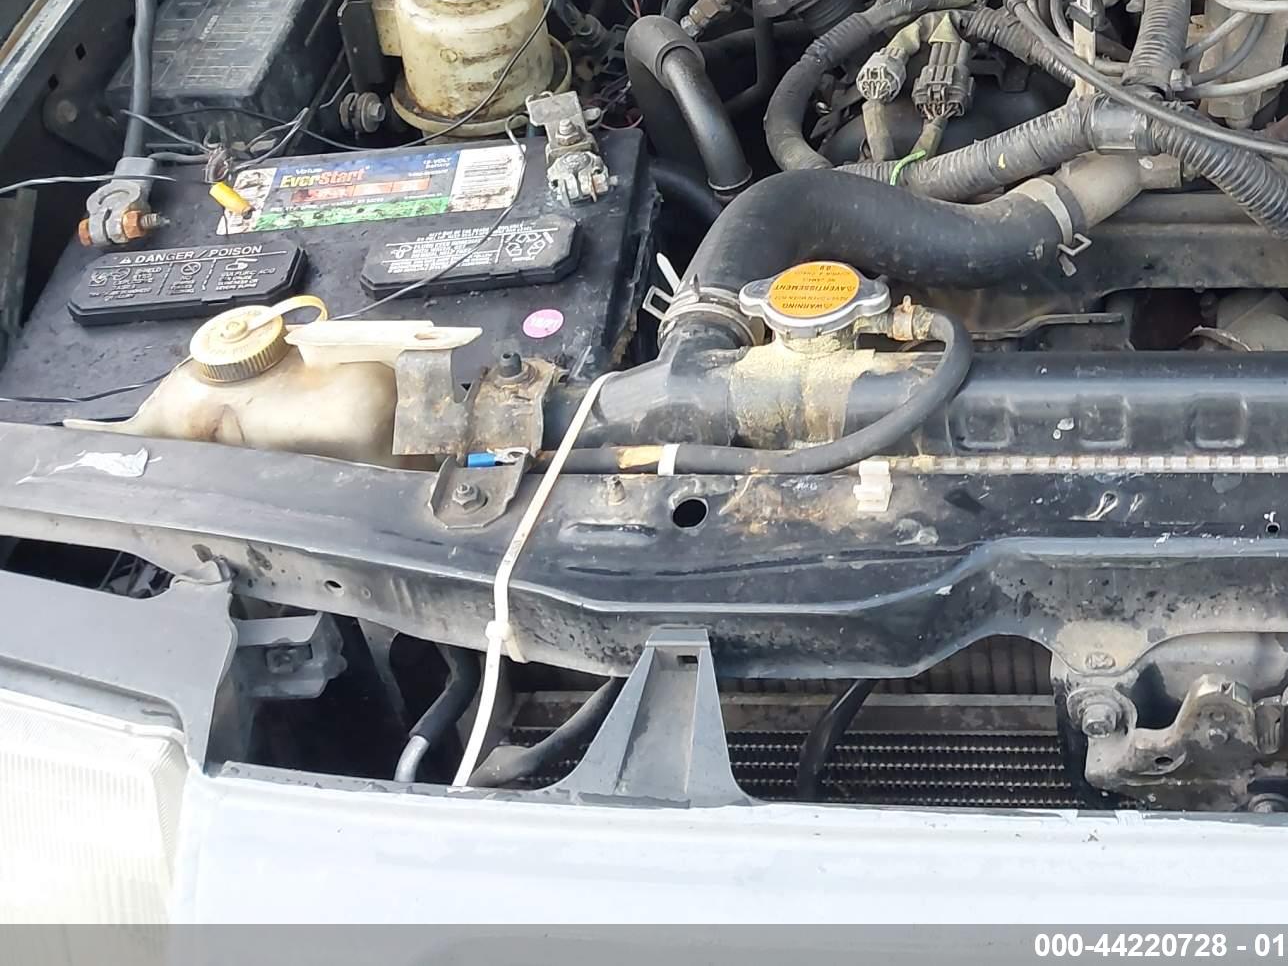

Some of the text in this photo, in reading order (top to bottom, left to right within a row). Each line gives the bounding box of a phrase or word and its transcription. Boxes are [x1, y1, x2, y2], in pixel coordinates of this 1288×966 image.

[280, 168, 365, 189] EverStart
[134, 251, 194, 264] DANGER
[209, 245, 263, 258] POISON
